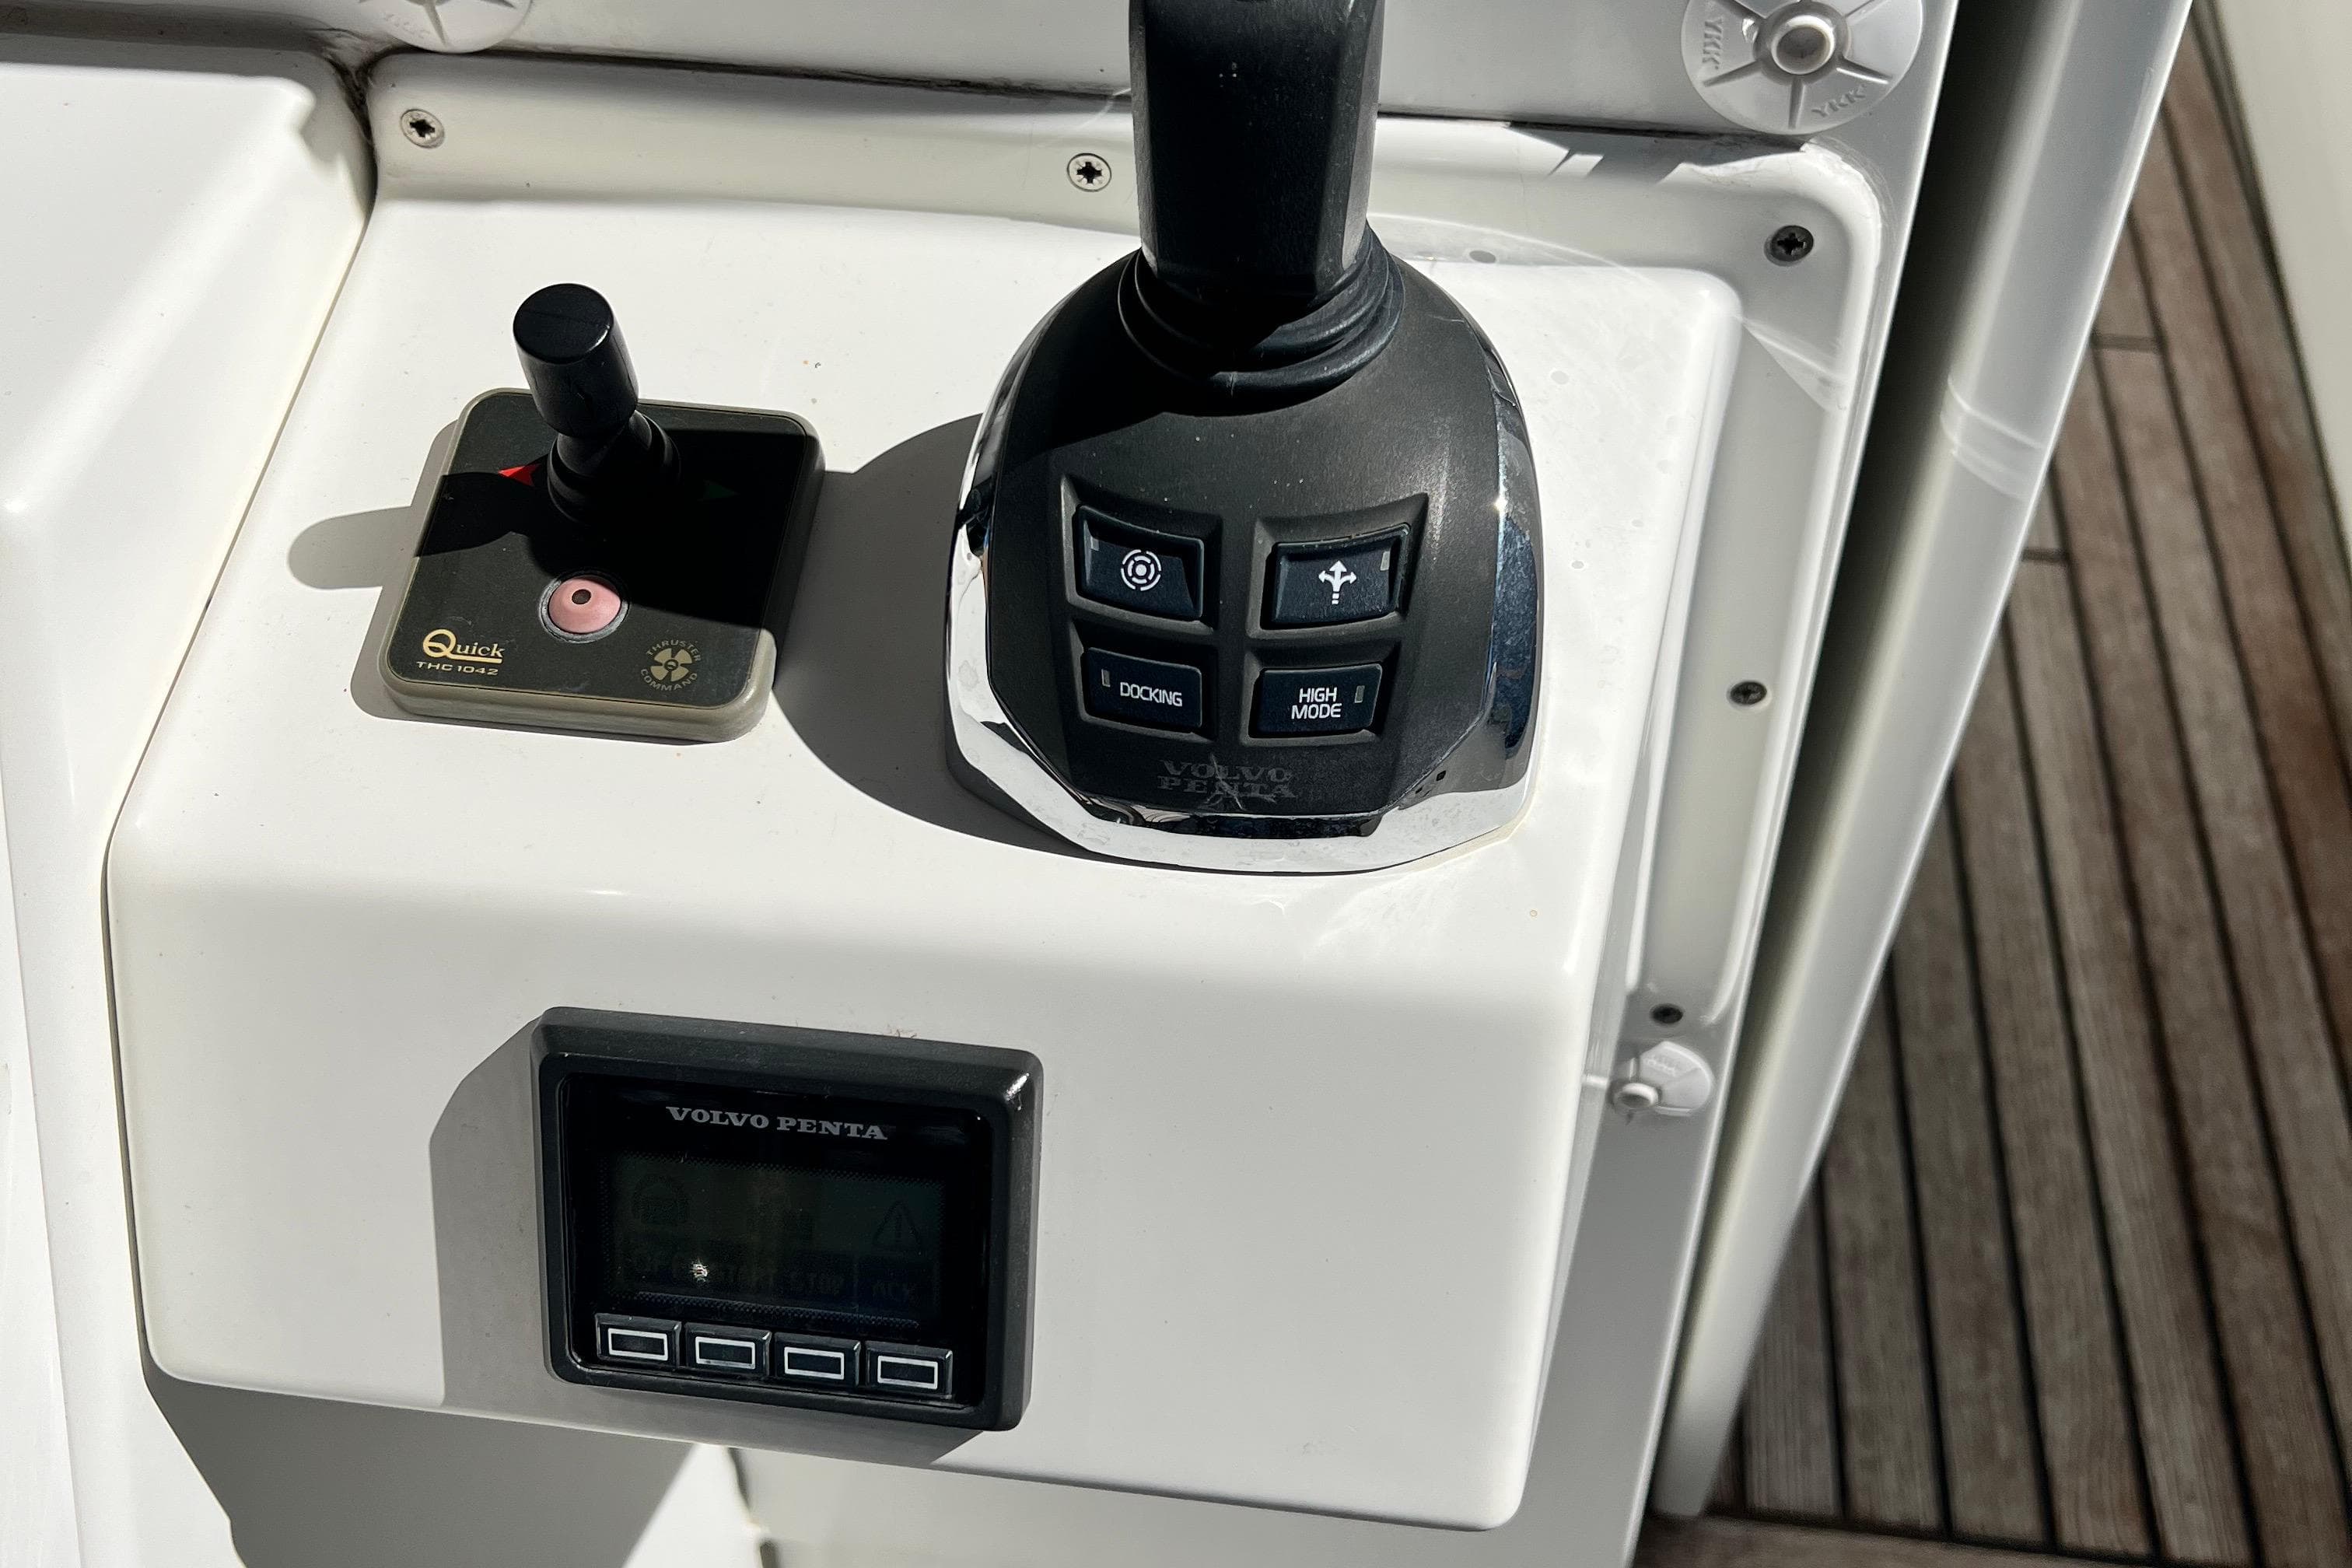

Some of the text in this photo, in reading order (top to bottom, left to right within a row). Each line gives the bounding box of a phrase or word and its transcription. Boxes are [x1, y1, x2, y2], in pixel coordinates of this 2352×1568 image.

[422, 628, 506, 664] Quick
[646, 639, 702, 662] THRUSTER
[416, 661, 499, 676] THC 1042
[640, 668, 698, 691] COMMAND
[1119, 681, 1183, 707] DOCKING
[1298, 687, 1337, 703] HIGH
[1291, 702, 1342, 719] MODE
[1160, 759, 1293, 782] VOLVO
[1157, 776, 1297, 799] PENTA
[666, 1106, 887, 1140] VOLVO PENTA
